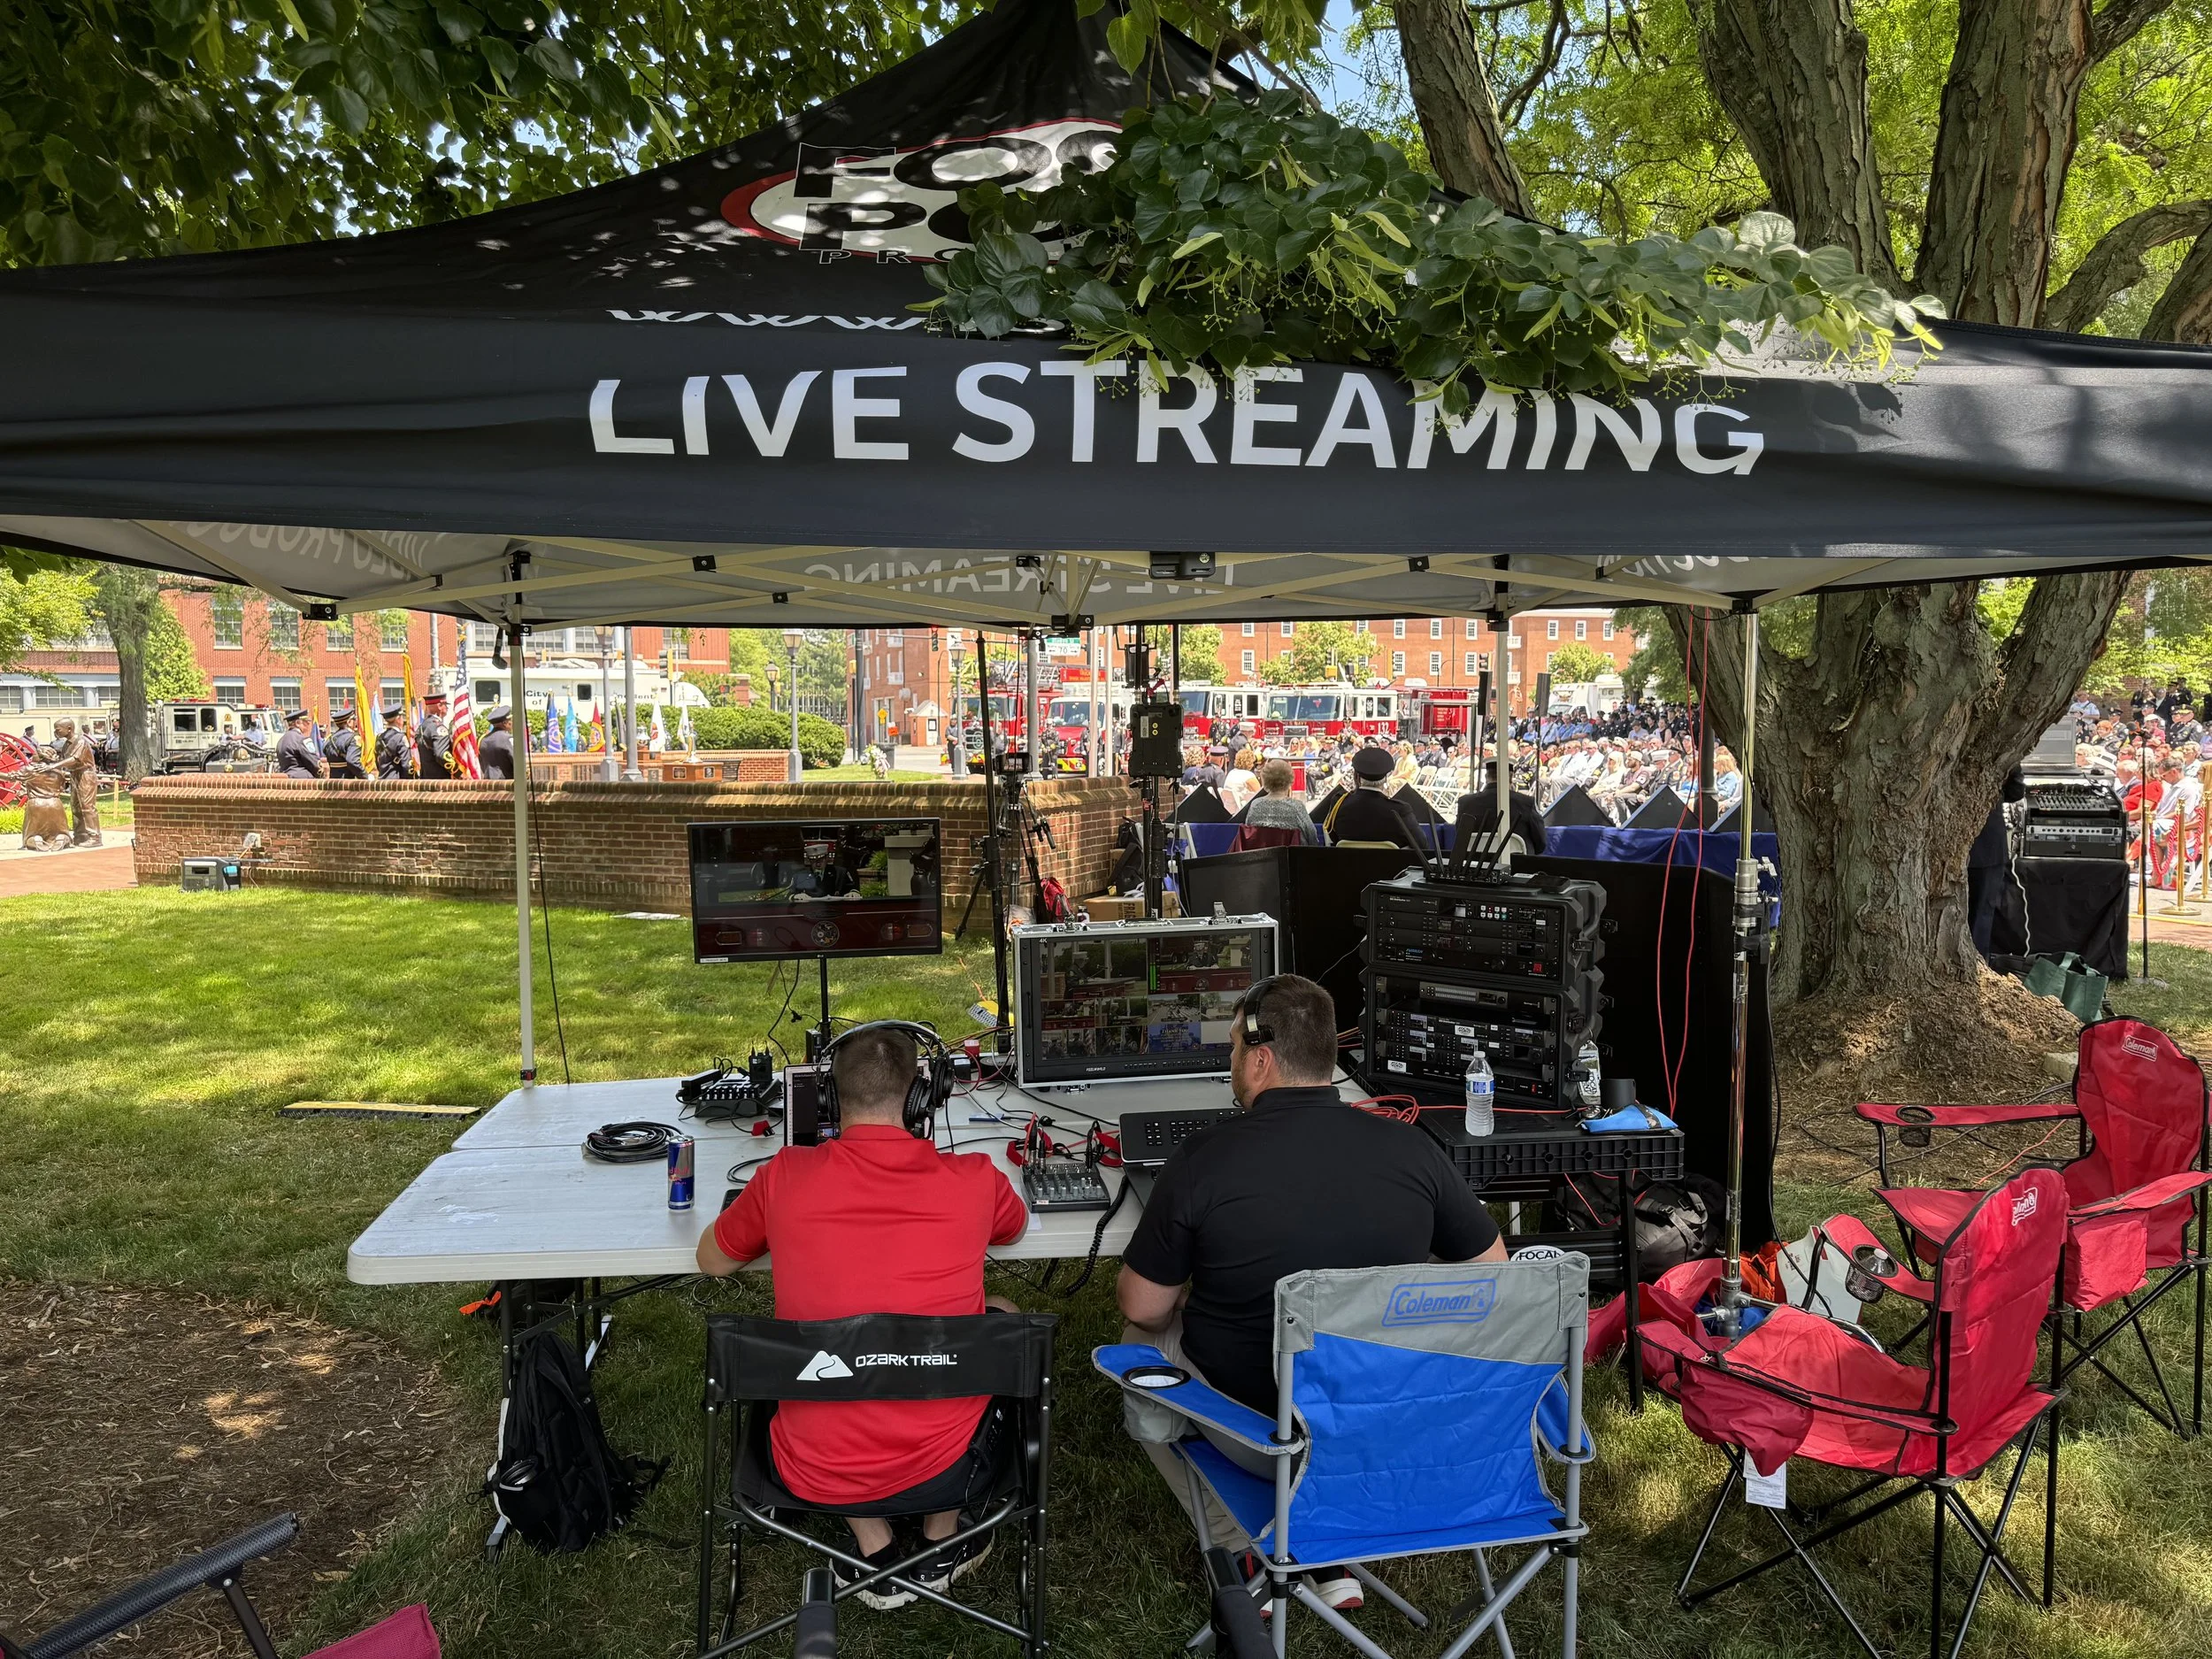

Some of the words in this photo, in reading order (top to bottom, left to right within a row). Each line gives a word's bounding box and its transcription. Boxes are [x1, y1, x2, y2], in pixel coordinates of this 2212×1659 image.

[588, 365, 910, 460] LIVE
[951, 361, 1765, 476] STREAMING
[1378, 722, 1390, 734] 132
[2125, 1037, 2153, 1055] Coleman
[1394, 1290, 1471, 1316] Coleman
[855, 1354, 909, 1368] OZARK
